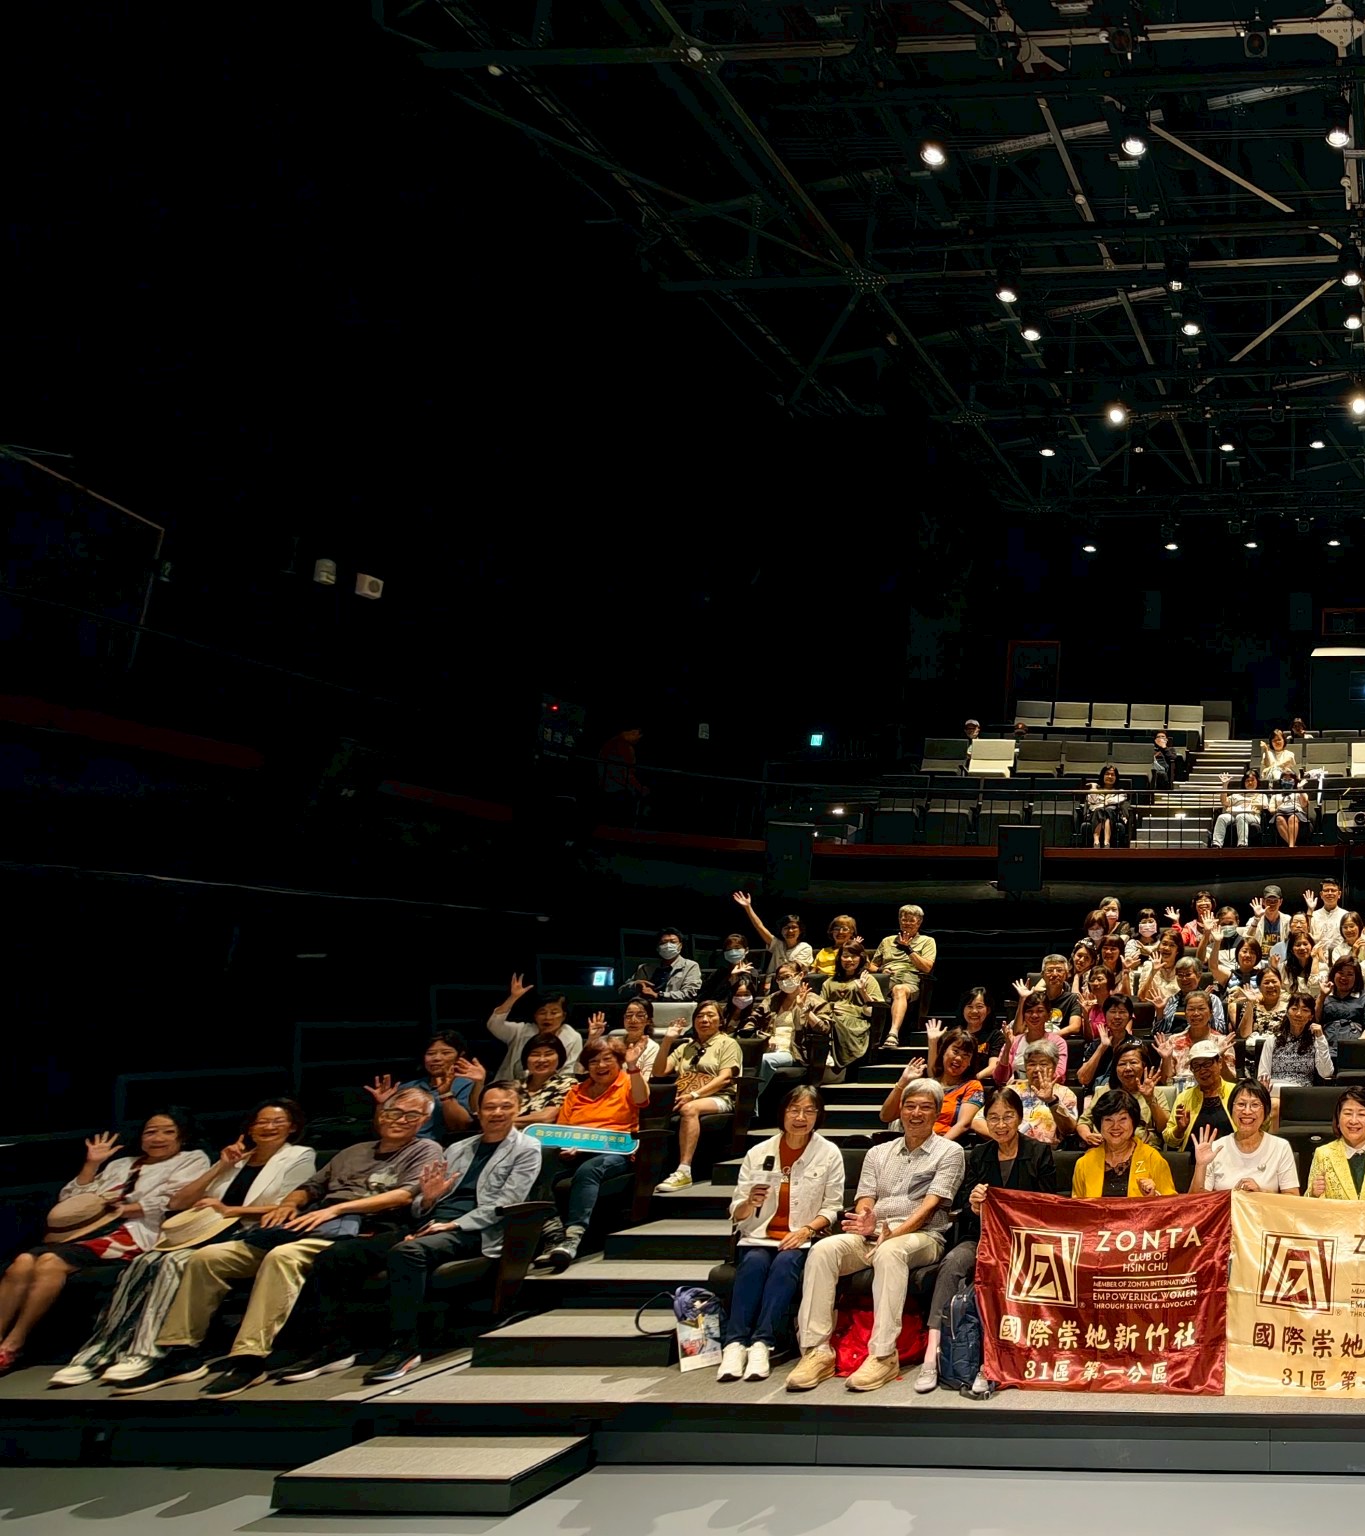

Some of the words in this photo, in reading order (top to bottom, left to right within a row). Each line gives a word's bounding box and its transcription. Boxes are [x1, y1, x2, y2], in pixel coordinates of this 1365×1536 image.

[1095, 1226, 1202, 1252] ZONTA
[1127, 1253, 1152, 1262] CLUB
[1153, 1251, 1168, 1261] OF
[1122, 1263, 1146, 1273] HSIN
[1147, 1262, 1169, 1272] CHU
[1092, 1280, 1117, 1288] MEMBER
[1118, 1280, 1127, 1288] OF
[1127, 1280, 1150, 1288] ZONTA
[1150, 1276, 1197, 1287] INTERNATIONAL
[1092, 1291, 1158, 1302] EMPOWERING
[1160, 1288, 1198, 1300] WOMEN
[1092, 1302, 1125, 1310] THROUGH
[1126, 1302, 1153, 1310] SERVICE
[1161, 1299, 1197, 1309] ADVOCACY
[999, 1314, 1197, 1352] 國際崇她新竹社
[1024, 1359, 1072, 1382] 31區
[1080, 1360, 1169, 1384] 第一分區
[1281, 1367, 1327, 1391] 31區
